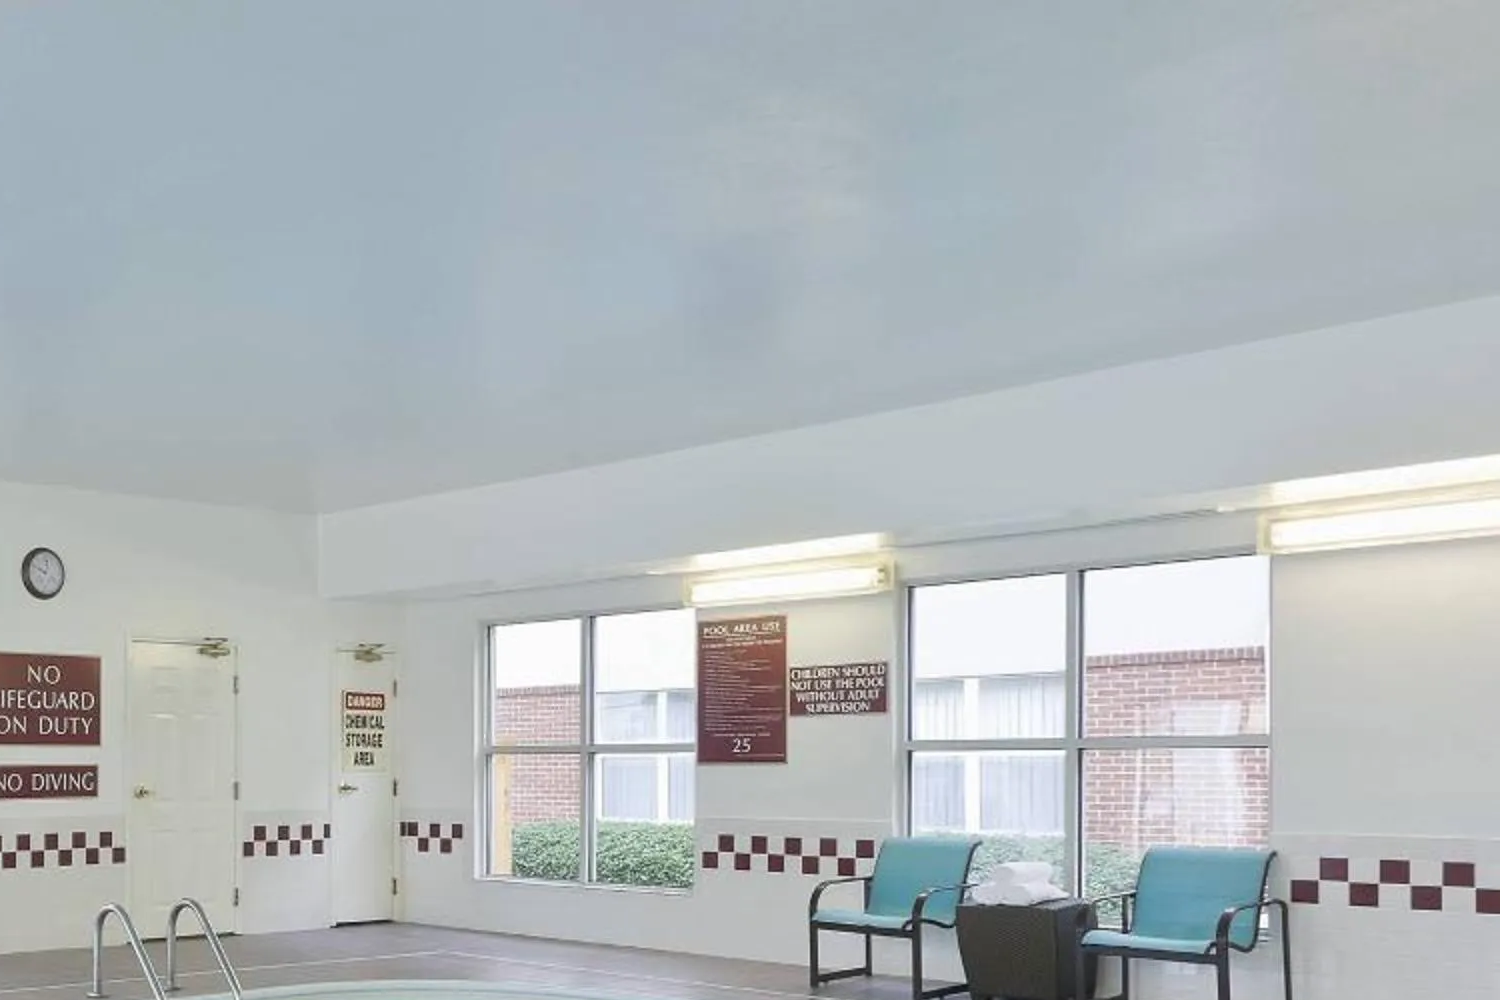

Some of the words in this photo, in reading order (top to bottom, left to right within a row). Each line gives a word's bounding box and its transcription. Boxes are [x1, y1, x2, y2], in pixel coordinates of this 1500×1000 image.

[703, 625, 728, 636] POOL
[733, 623, 759, 633] AREA
[761, 621, 781, 632] USE
[27, 664, 61, 685] NO
[791, 668, 840, 680] CHILDREN
[842, 664, 885, 677] SHOULD
[791, 680, 812, 691] NOT
[815, 680, 832, 690] USE
[835, 679, 855, 689] THE
[855, 677, 885, 688] POOL
[347, 695, 383, 708] DANGER
[796, 690, 846, 703] WITHOUT
[847, 689, 880, 701] ADULT
[805, 701, 871, 713] SUPERVISION
[39, 716, 94, 735] DUTY
[345, 715, 385, 729] CHEMICAL
[345, 733, 383, 748] STORAGE
[732, 737, 752, 753] 25
[353, 751, 375, 766] AREA
[31, 772, 95, 792] DIVING
